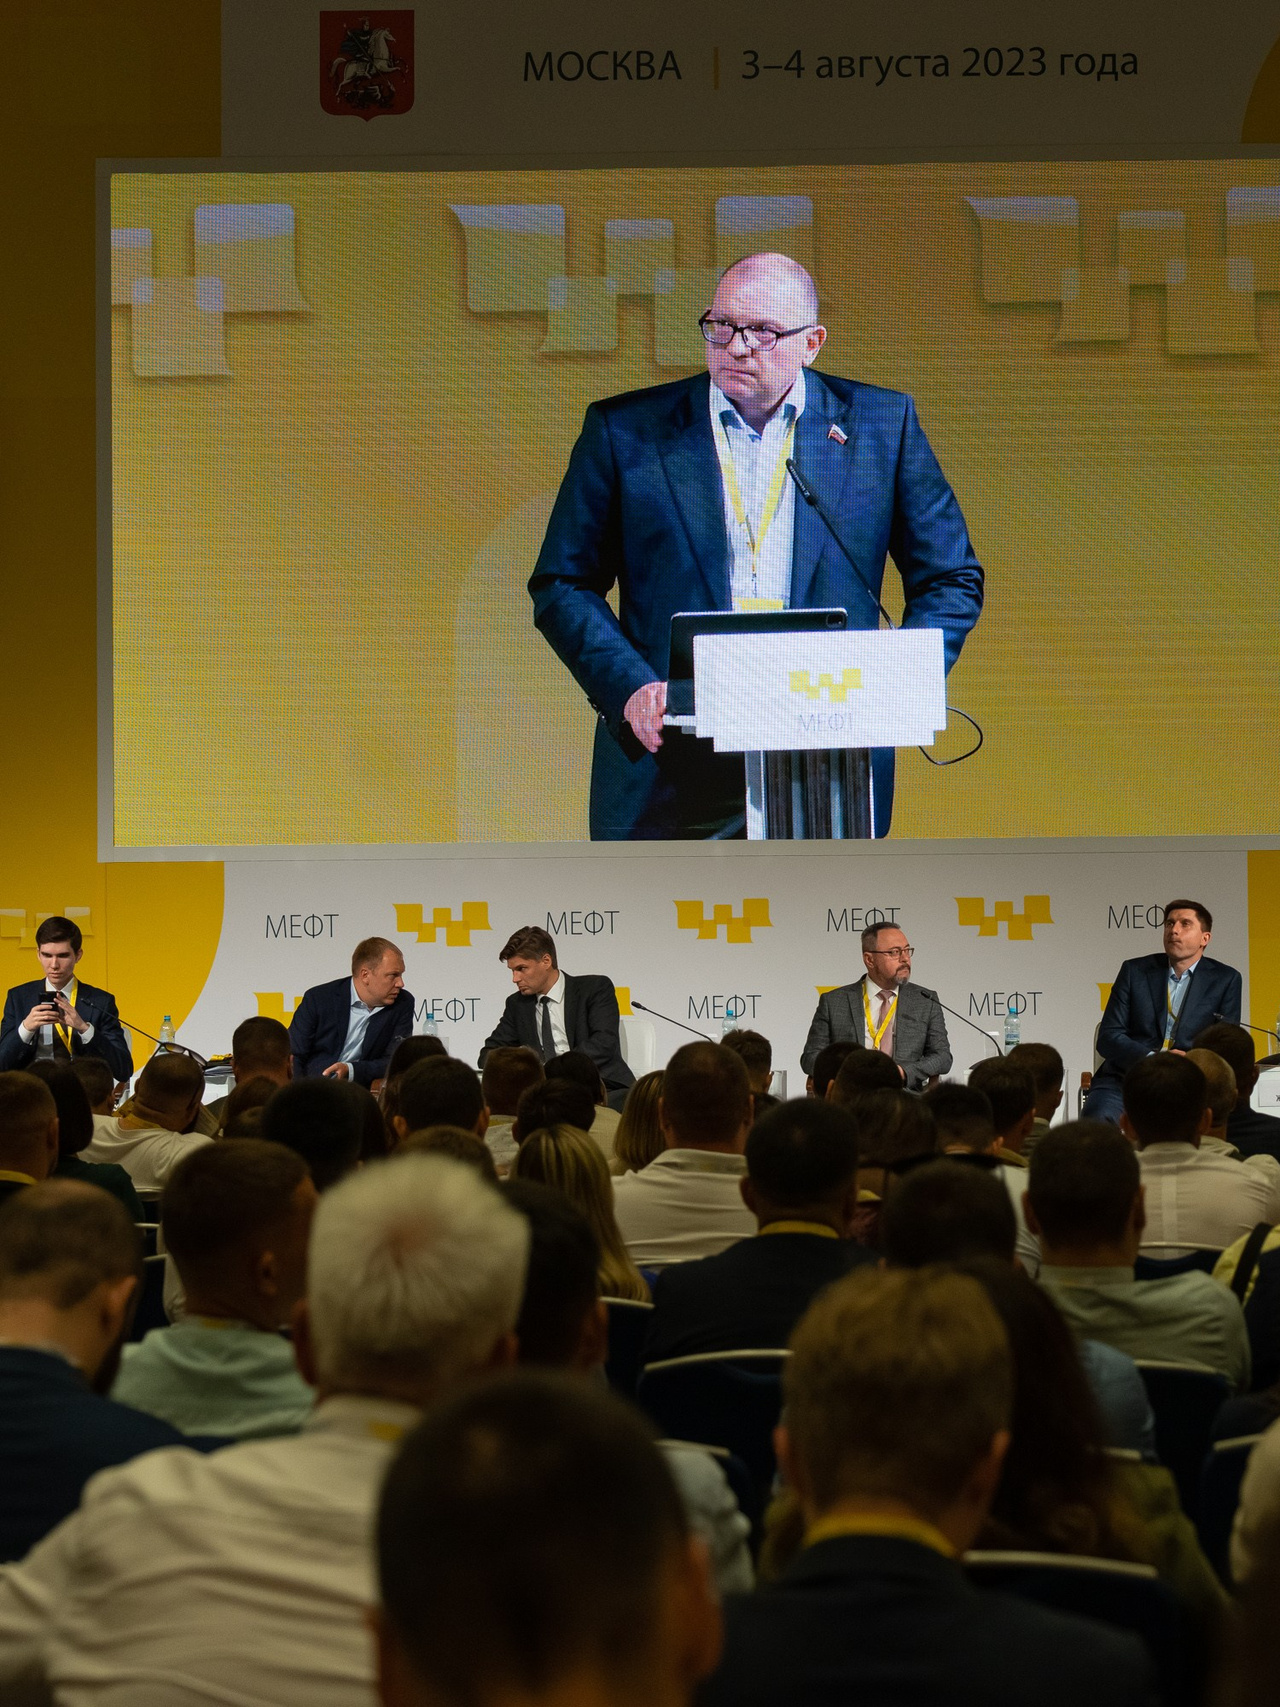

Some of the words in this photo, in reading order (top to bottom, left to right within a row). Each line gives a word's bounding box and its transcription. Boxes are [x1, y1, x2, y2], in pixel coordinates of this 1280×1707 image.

[523, 50, 682, 82] МОСКВА
[815, 54, 950, 87] августа
[961, 46, 1047, 77] 2023
[1060, 52, 1138, 82] года
[265, 913, 339, 939] МЕФТ
[546, 910, 620, 935] МЕФТ
[1107, 903, 1165, 929] МЕФ
[687, 994, 762, 1019] МЕФТ
[968, 991, 1043, 1017] МЕФТ
